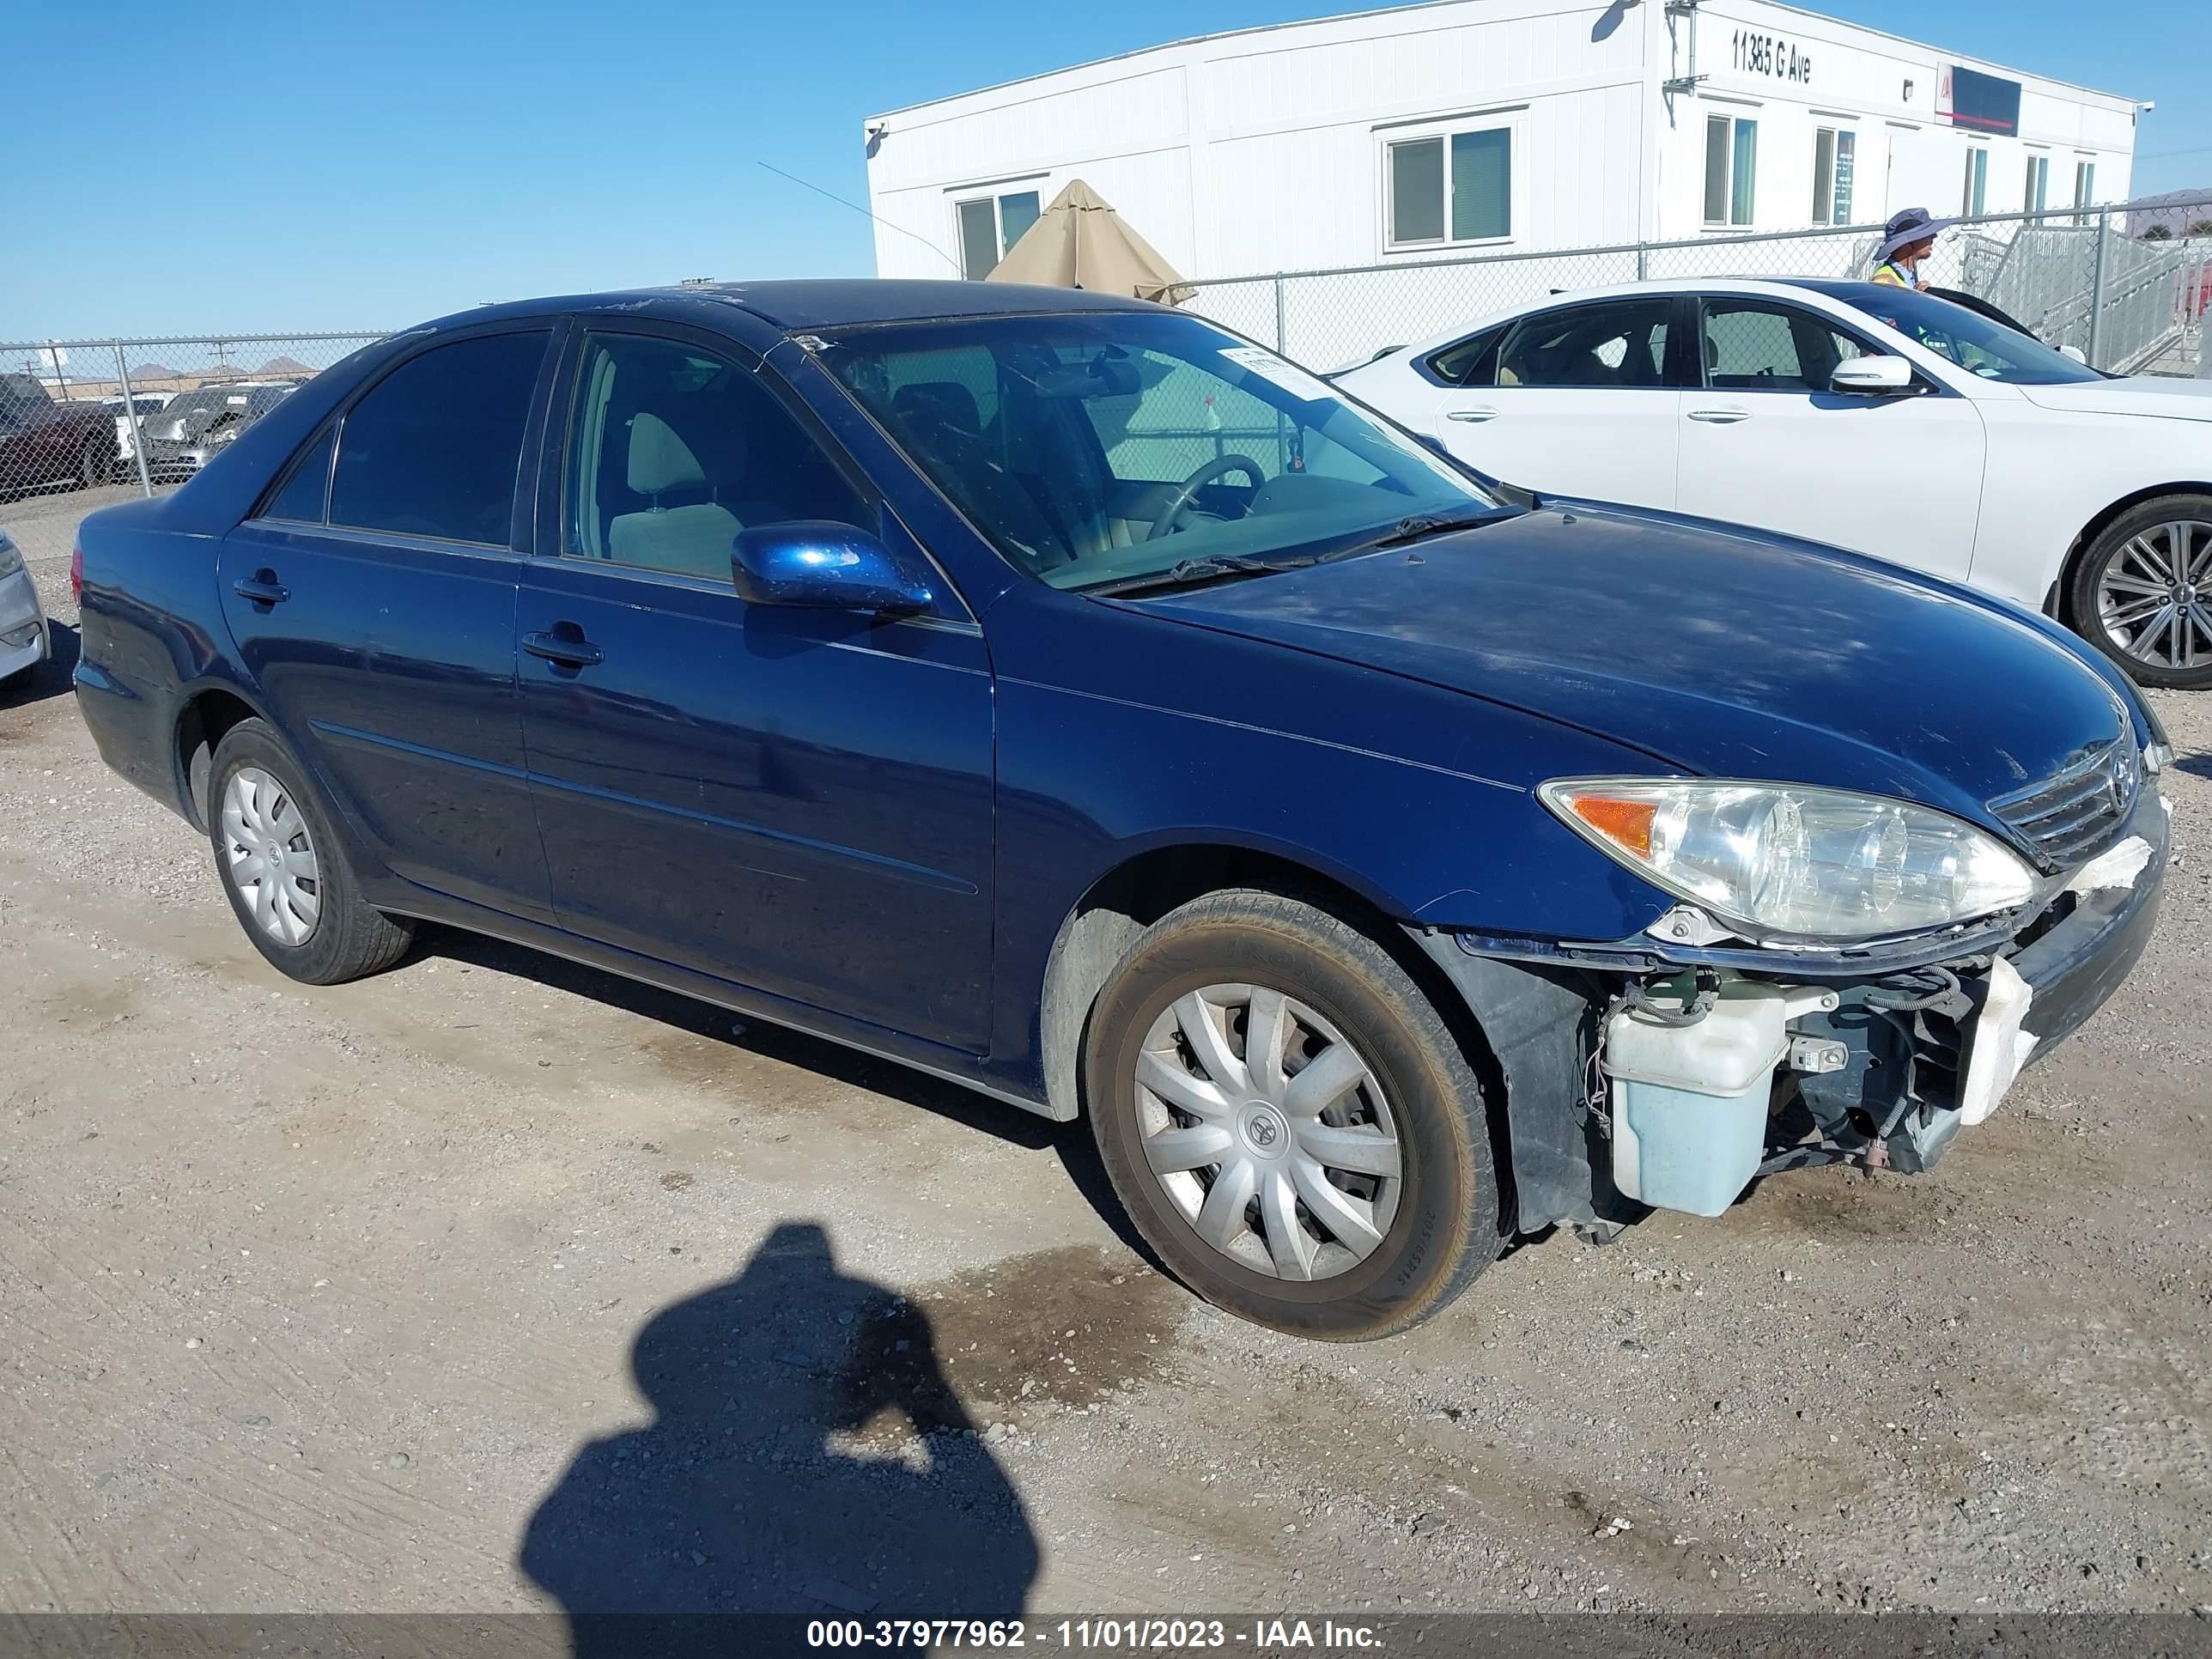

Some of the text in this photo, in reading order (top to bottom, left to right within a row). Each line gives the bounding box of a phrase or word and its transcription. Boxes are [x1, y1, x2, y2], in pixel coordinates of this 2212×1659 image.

[1732, 28, 1811, 84] 11385 G Ave
